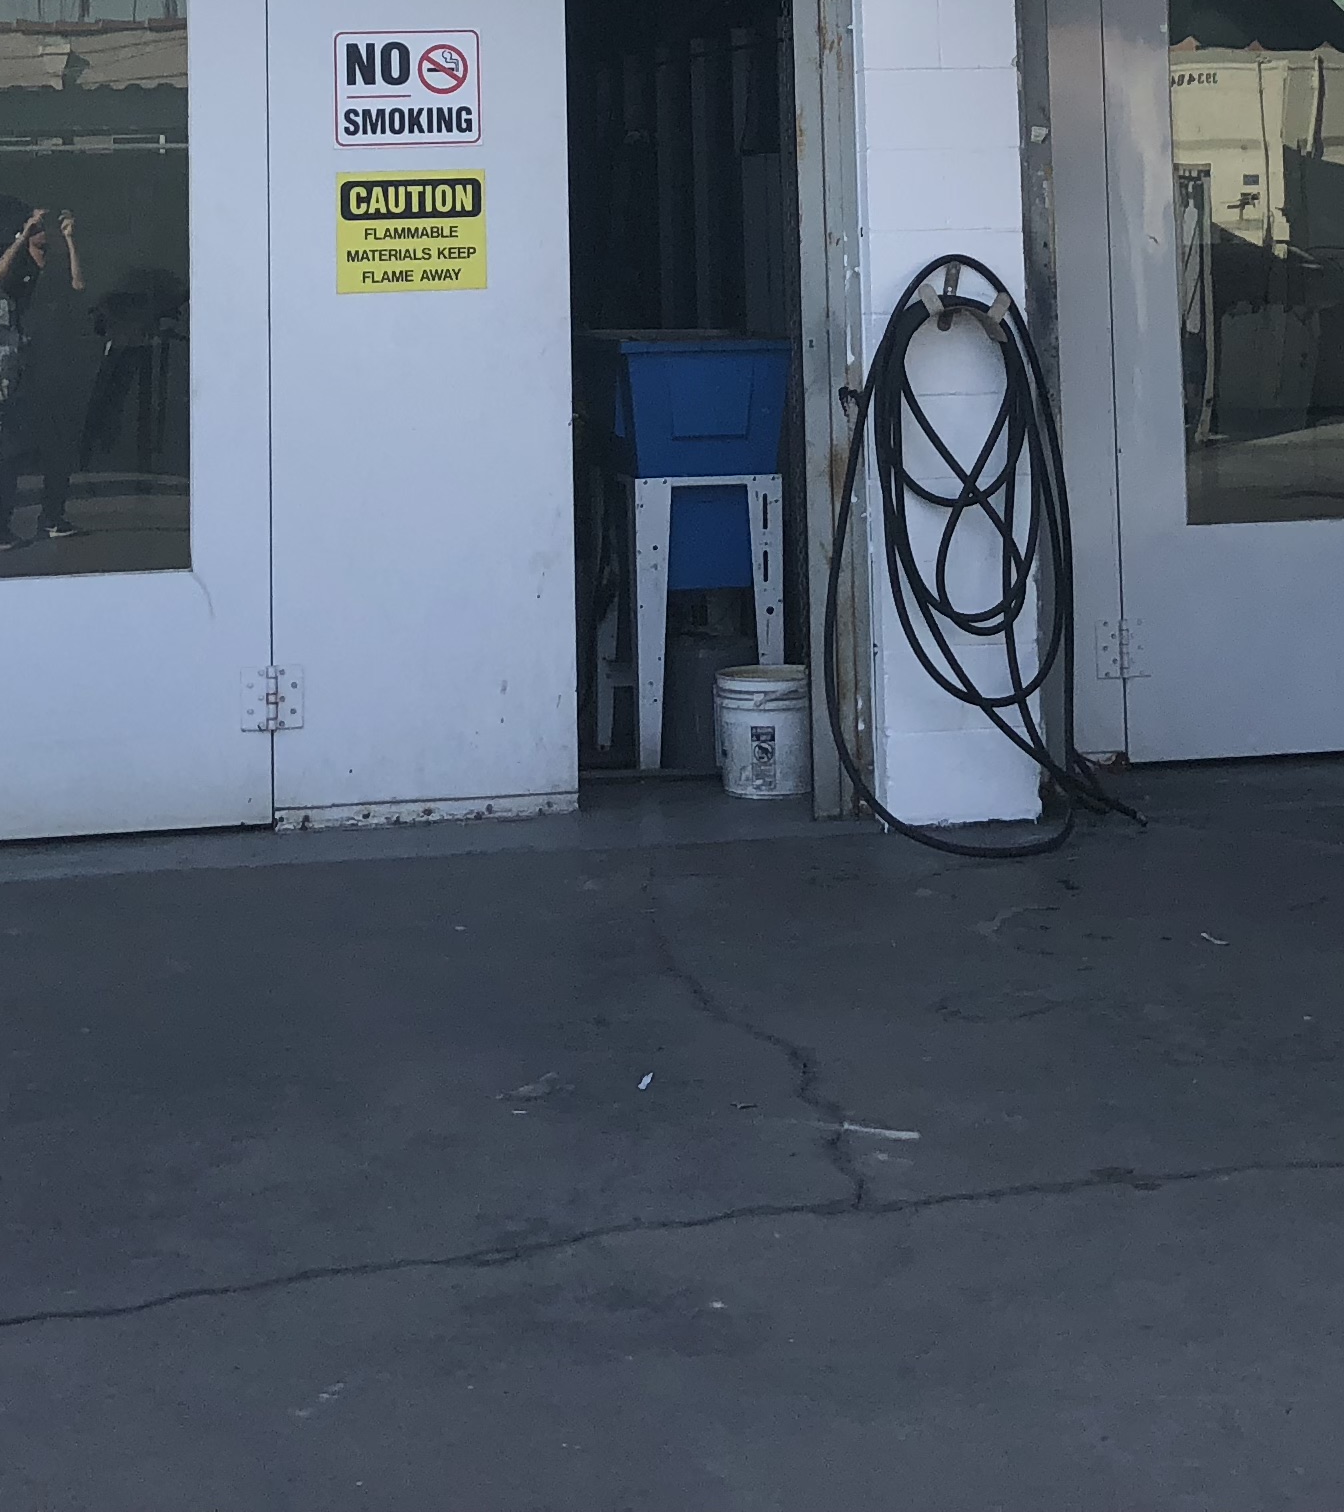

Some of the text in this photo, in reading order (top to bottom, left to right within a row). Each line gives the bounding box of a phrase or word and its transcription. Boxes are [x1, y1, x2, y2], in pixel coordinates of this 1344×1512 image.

[345, 41, 411, 86] NO
[343, 106, 473, 136] SMOKING
[349, 184, 473, 215] CAUTION
[364, 226, 459, 241] FLAMMABLE
[346, 246, 477, 263] MATERIALS KEEP
[362, 268, 462, 284] FLAME AWAY
